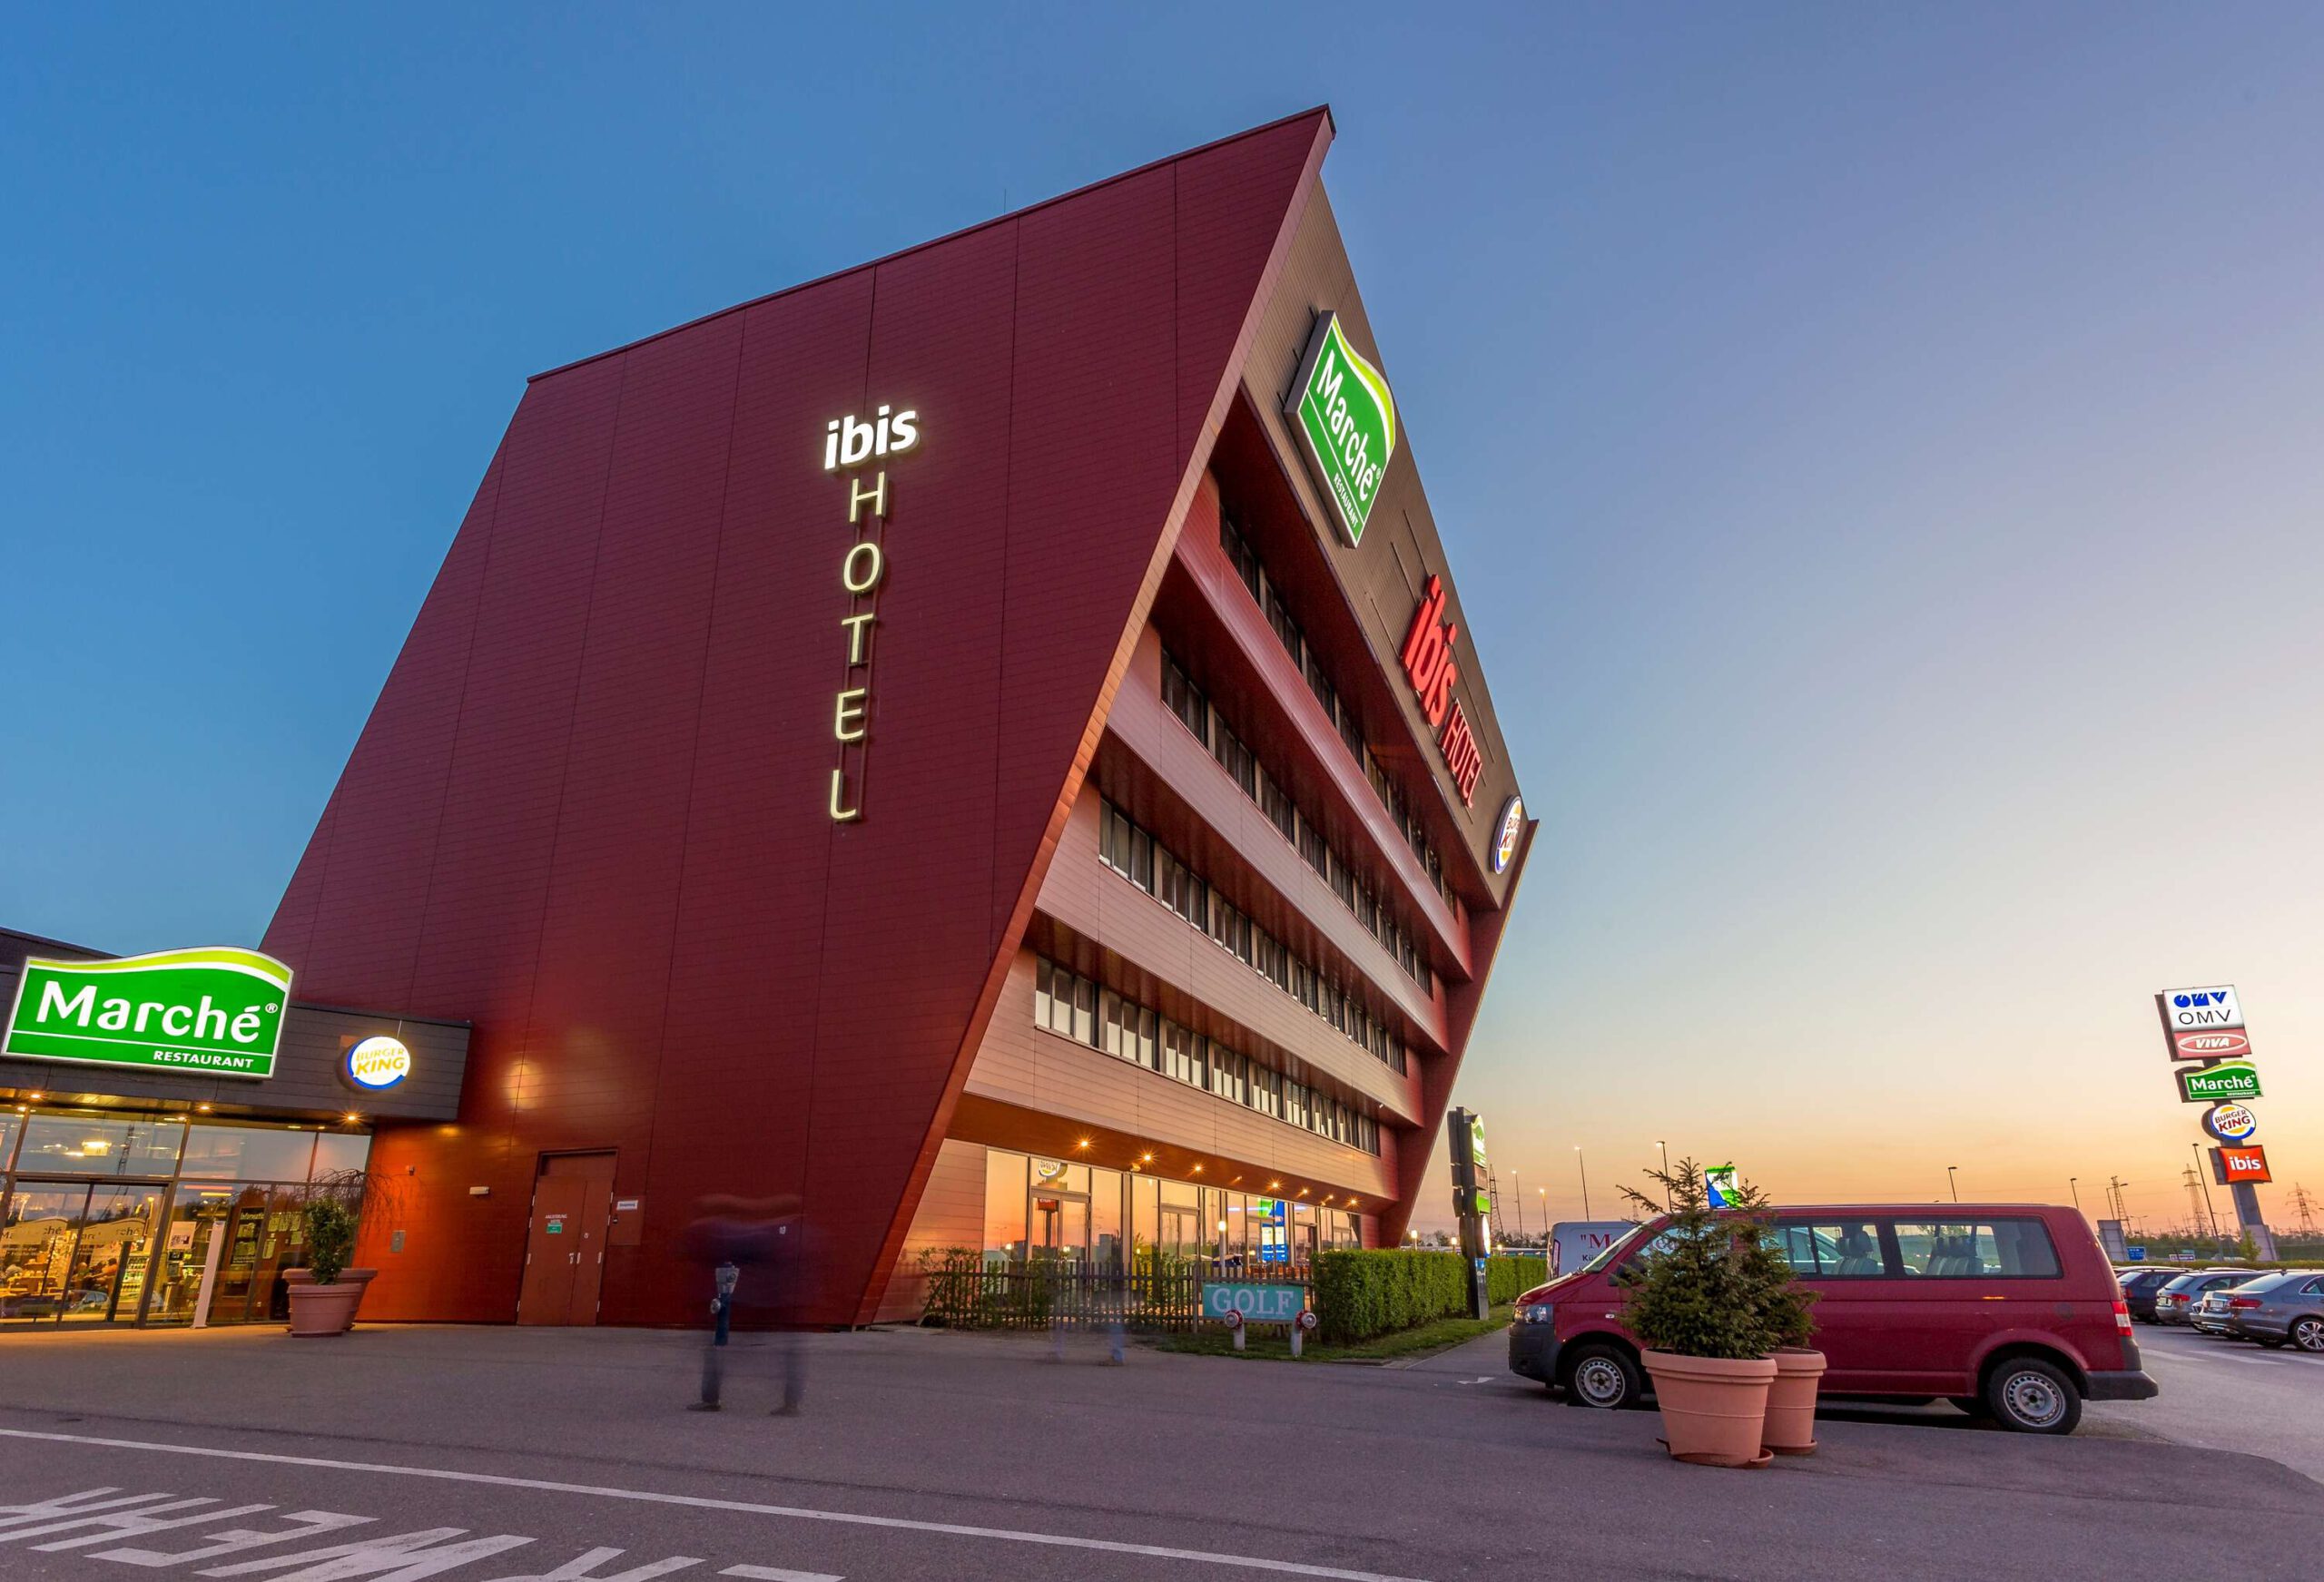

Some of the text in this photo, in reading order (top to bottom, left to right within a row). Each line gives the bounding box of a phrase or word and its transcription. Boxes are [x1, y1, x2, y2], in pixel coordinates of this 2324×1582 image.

[824, 404, 920, 470] ibis
[1333, 472, 1359, 529] RESTAURANT
[829, 471, 886, 820] HOTEL
[1401, 574, 1457, 726] ibis
[1440, 697, 1482, 809] HOTEL
[2179, 1009, 2230, 1025] OMV
[2195, 1037, 2230, 1048] VIVA
[153, 1049, 254, 1069] RESTAURANT
[356, 1046, 405, 1062] BURGER
[355, 1056, 405, 1076] KING
[2214, 1109, 2247, 1125] BURGER
[2219, 1115, 2250, 1132] KING
[2229, 1155, 2261, 1171] ibis
[1212, 1287, 1295, 1316] GOLF
